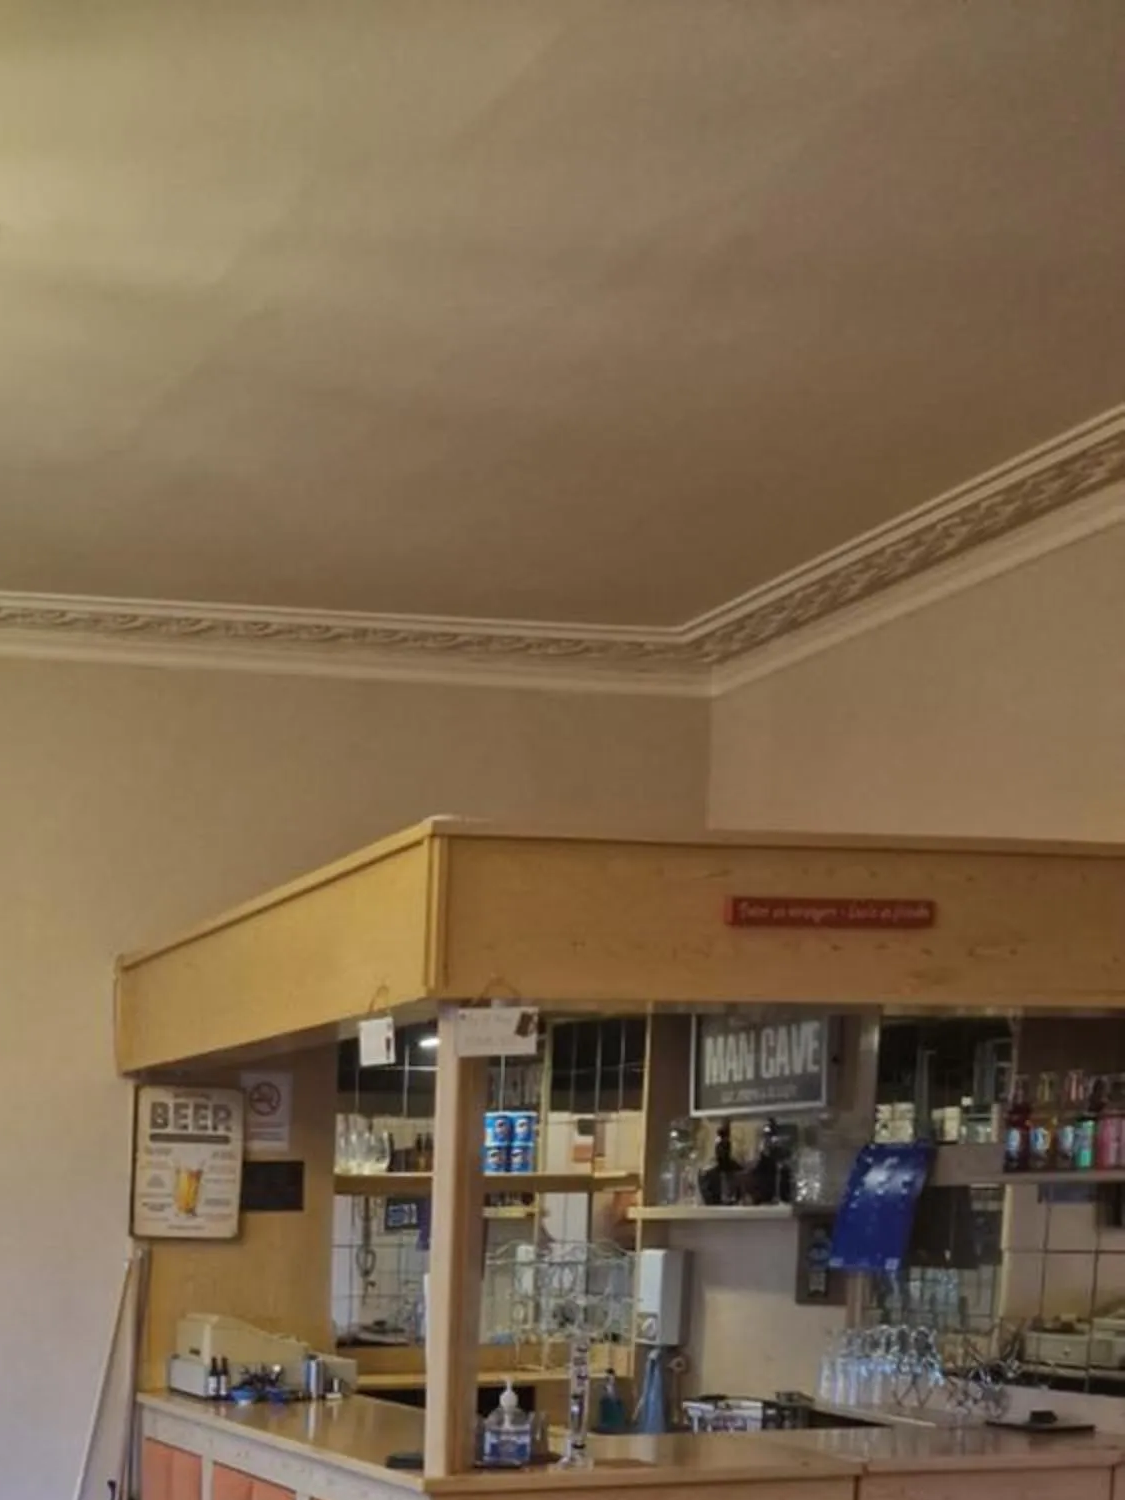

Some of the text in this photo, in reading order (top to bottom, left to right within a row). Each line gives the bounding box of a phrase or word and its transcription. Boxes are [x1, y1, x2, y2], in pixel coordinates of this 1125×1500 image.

[704, 1021, 820, 1085] MAN CAVE
[150, 1102, 233, 1132] BEER
